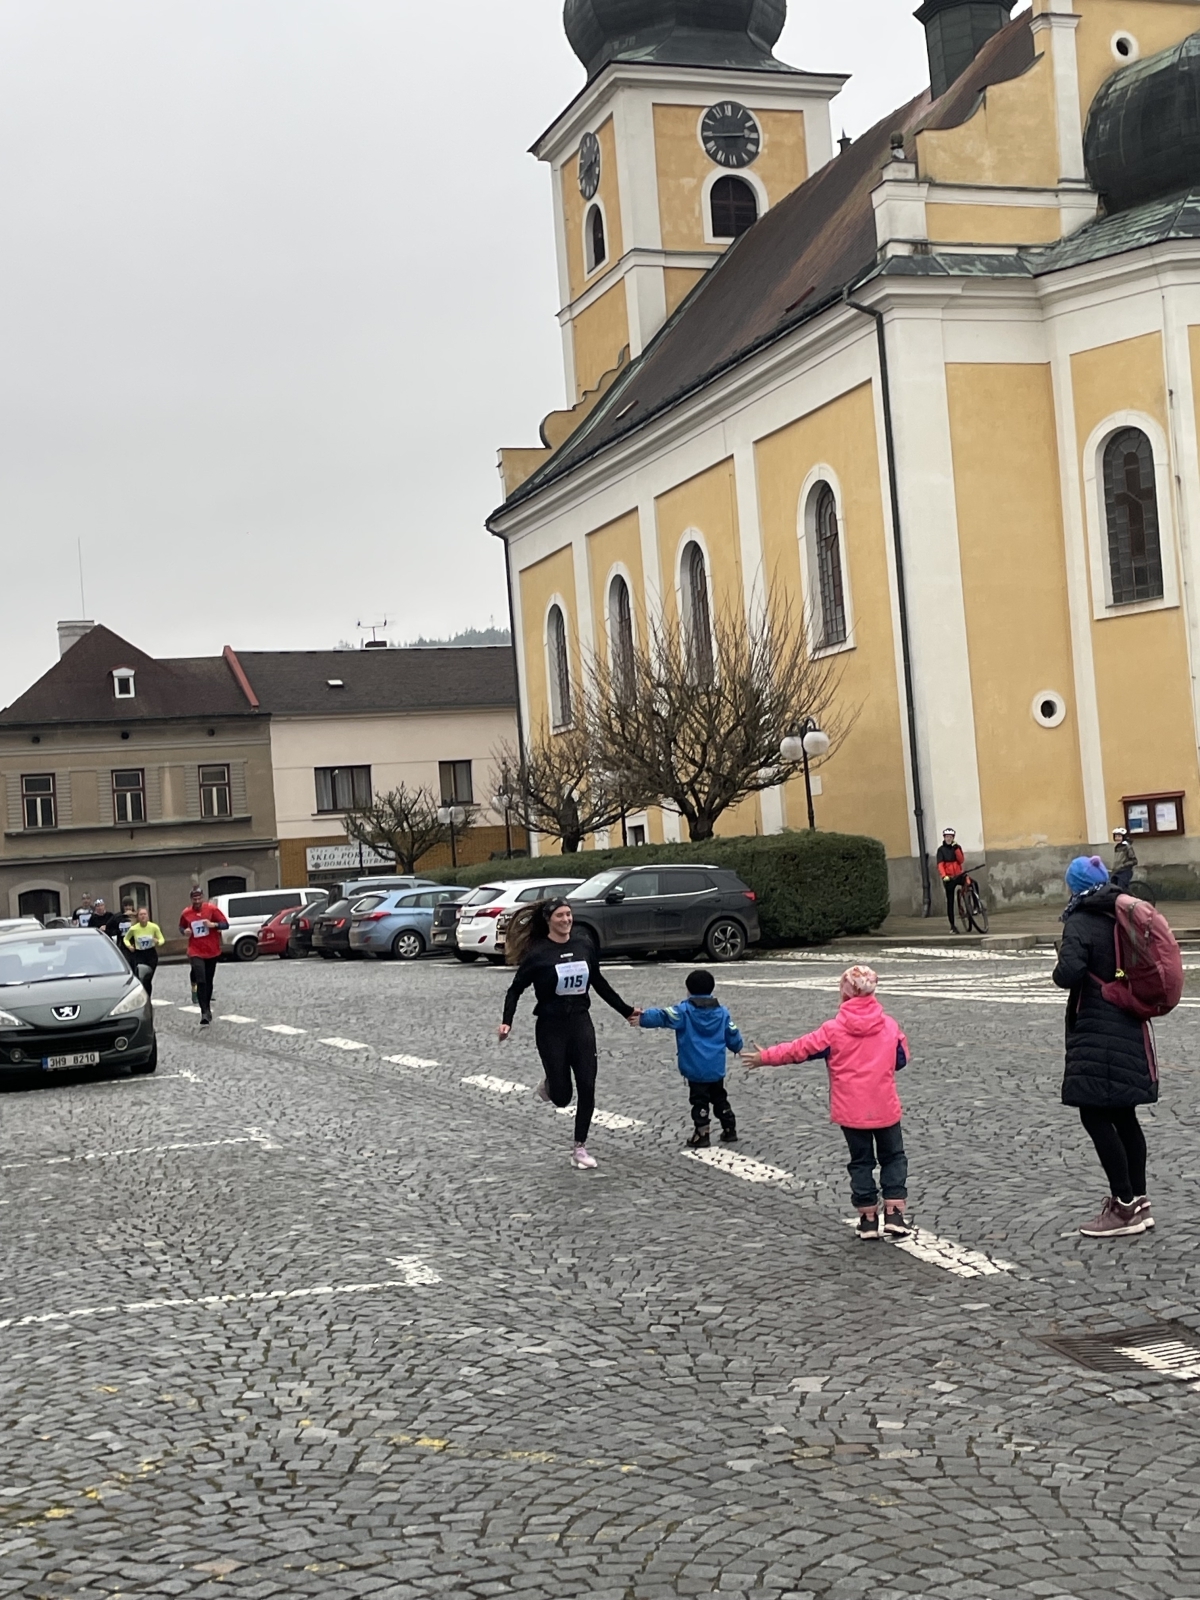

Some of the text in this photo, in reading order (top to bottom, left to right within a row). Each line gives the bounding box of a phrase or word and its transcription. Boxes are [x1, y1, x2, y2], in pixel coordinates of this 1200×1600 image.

[311, 853, 336, 861] SKLO
[564, 975, 583, 988] 115
[50, 1053, 96, 1067] 3H9 8210
